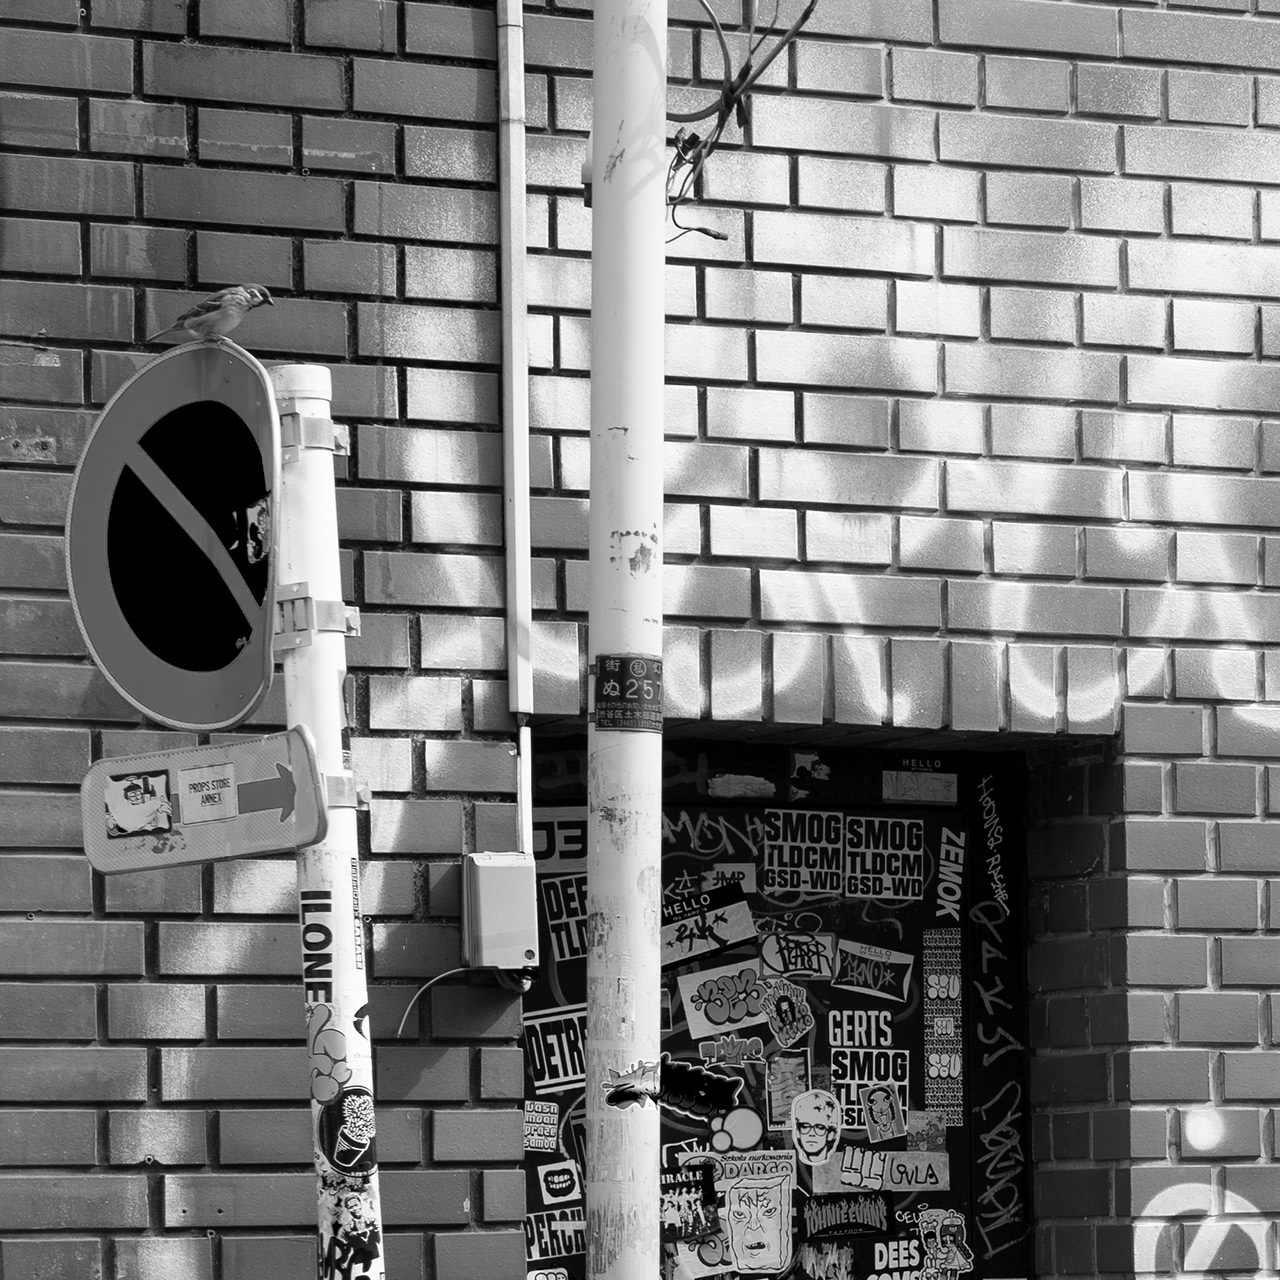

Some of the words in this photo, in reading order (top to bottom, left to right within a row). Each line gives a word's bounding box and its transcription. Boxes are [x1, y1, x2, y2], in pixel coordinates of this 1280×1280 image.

[902, 758, 942, 769] HELLO
[188, 781, 211, 795] PROPS
[211, 777, 231, 792] STORE
[200, 792, 223, 806] ANNEX
[764, 811, 842, 845] SMOG
[847, 818, 923, 852] SMOG
[767, 844, 841, 871] TLDCM
[847, 851, 923, 877] TLDCM
[764, 868, 842, 891] GSD-WD
[847, 875, 923, 897] GSD-WD
[935, 826, 966, 922] ZEMOK
[663, 894, 712, 918] HELLO
[860, 944, 892, 957] HELLO
[828, 1009, 893, 1047] GERTS
[832, 1050, 908, 1082] SMOG
[874, 1239, 921, 1271] DEES
